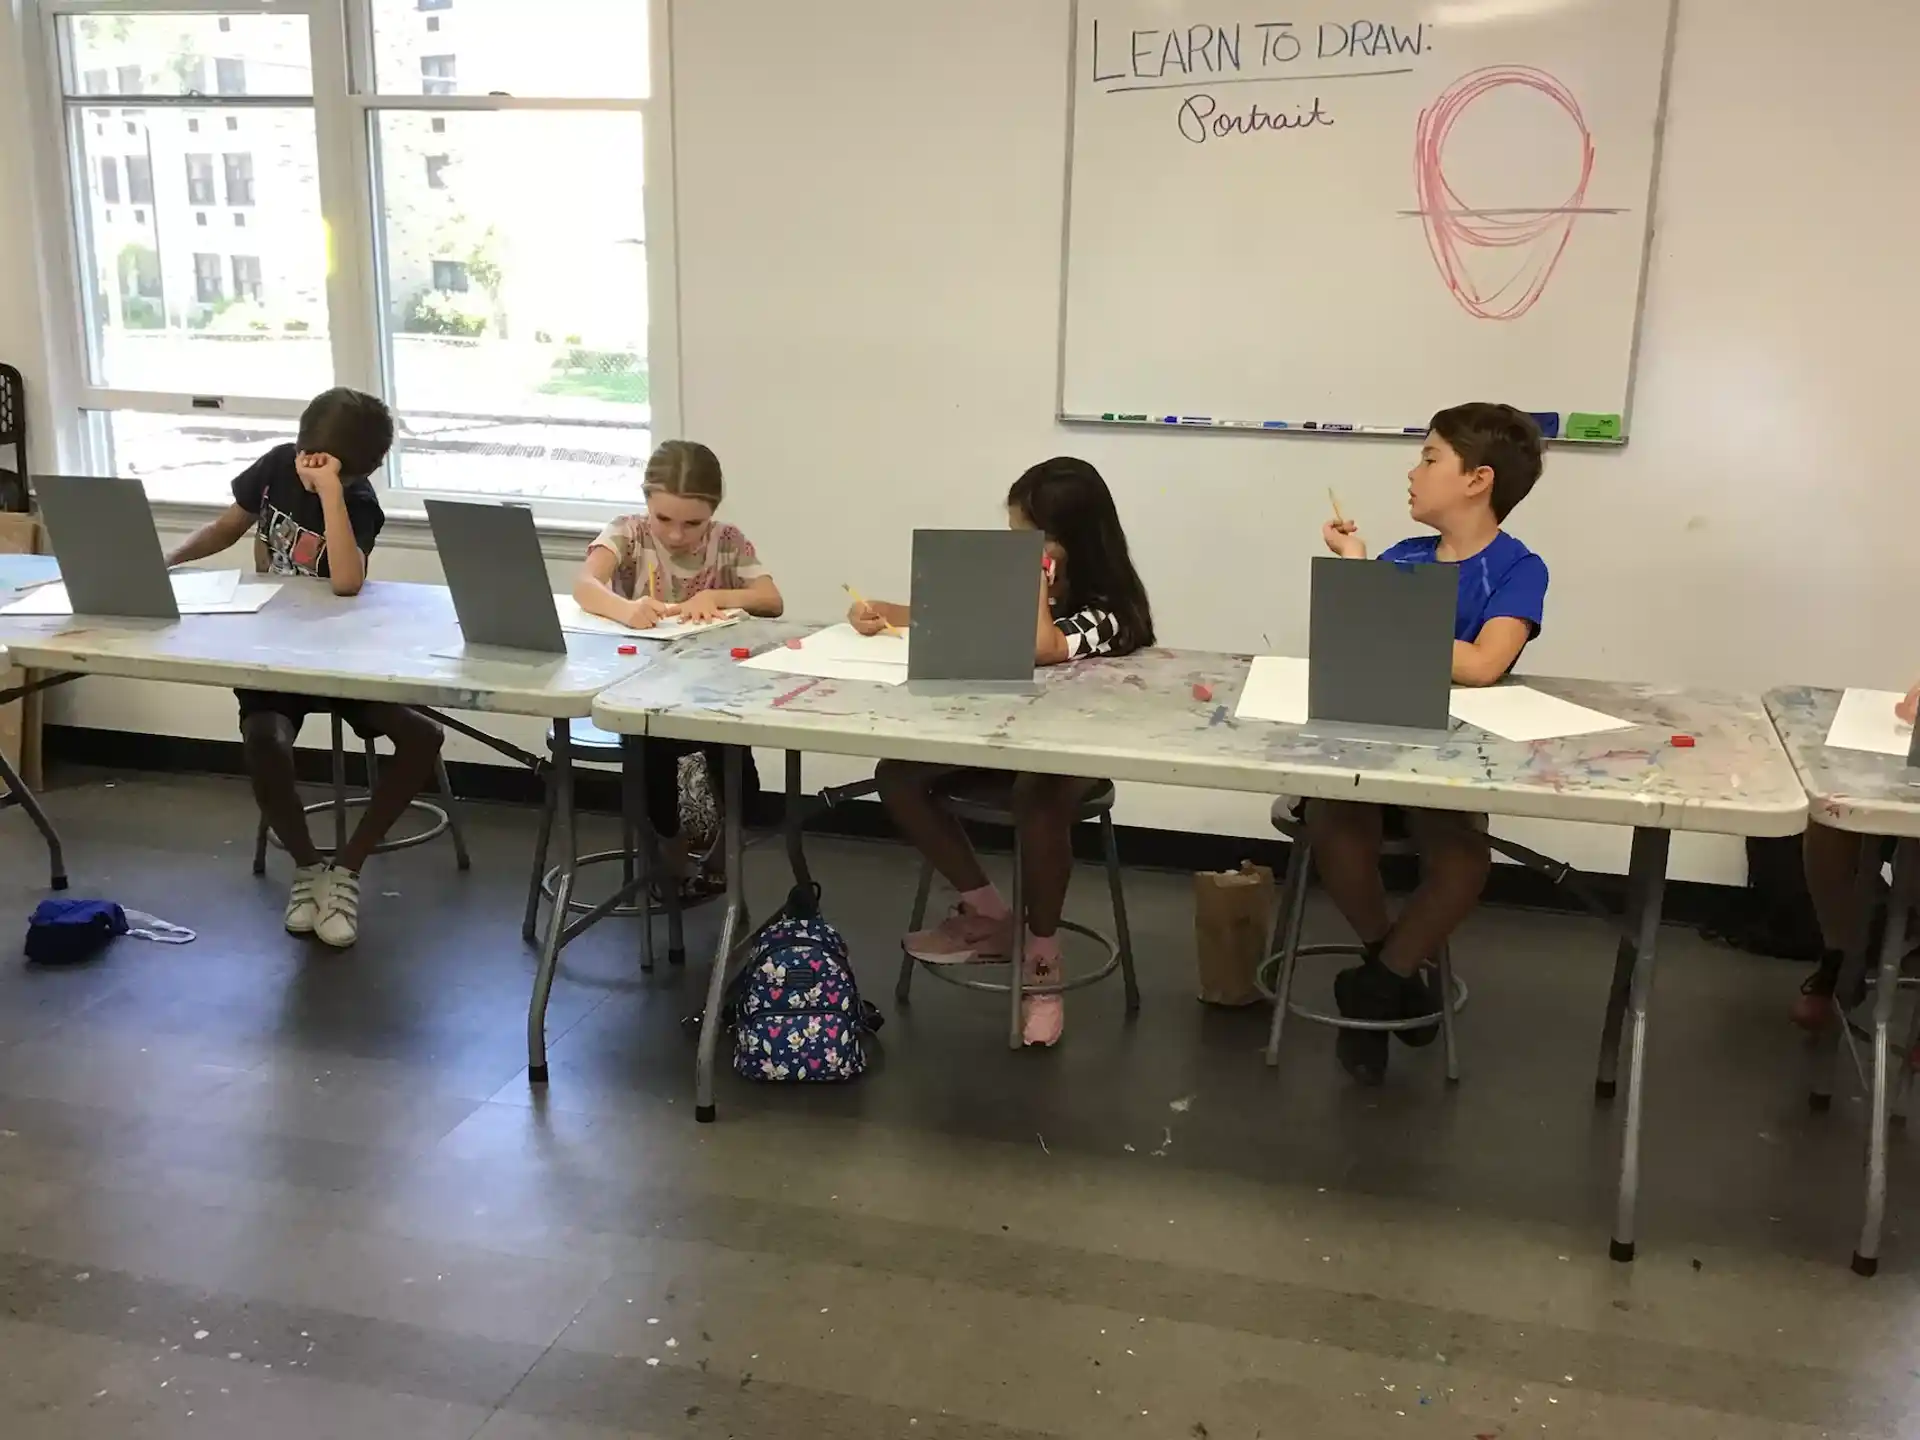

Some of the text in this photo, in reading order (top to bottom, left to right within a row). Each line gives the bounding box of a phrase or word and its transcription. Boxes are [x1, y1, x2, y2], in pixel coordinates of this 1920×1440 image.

[1093, 19, 1433, 83] LEARN TO DRAW:
[1177, 94, 1335, 144] Portrait
